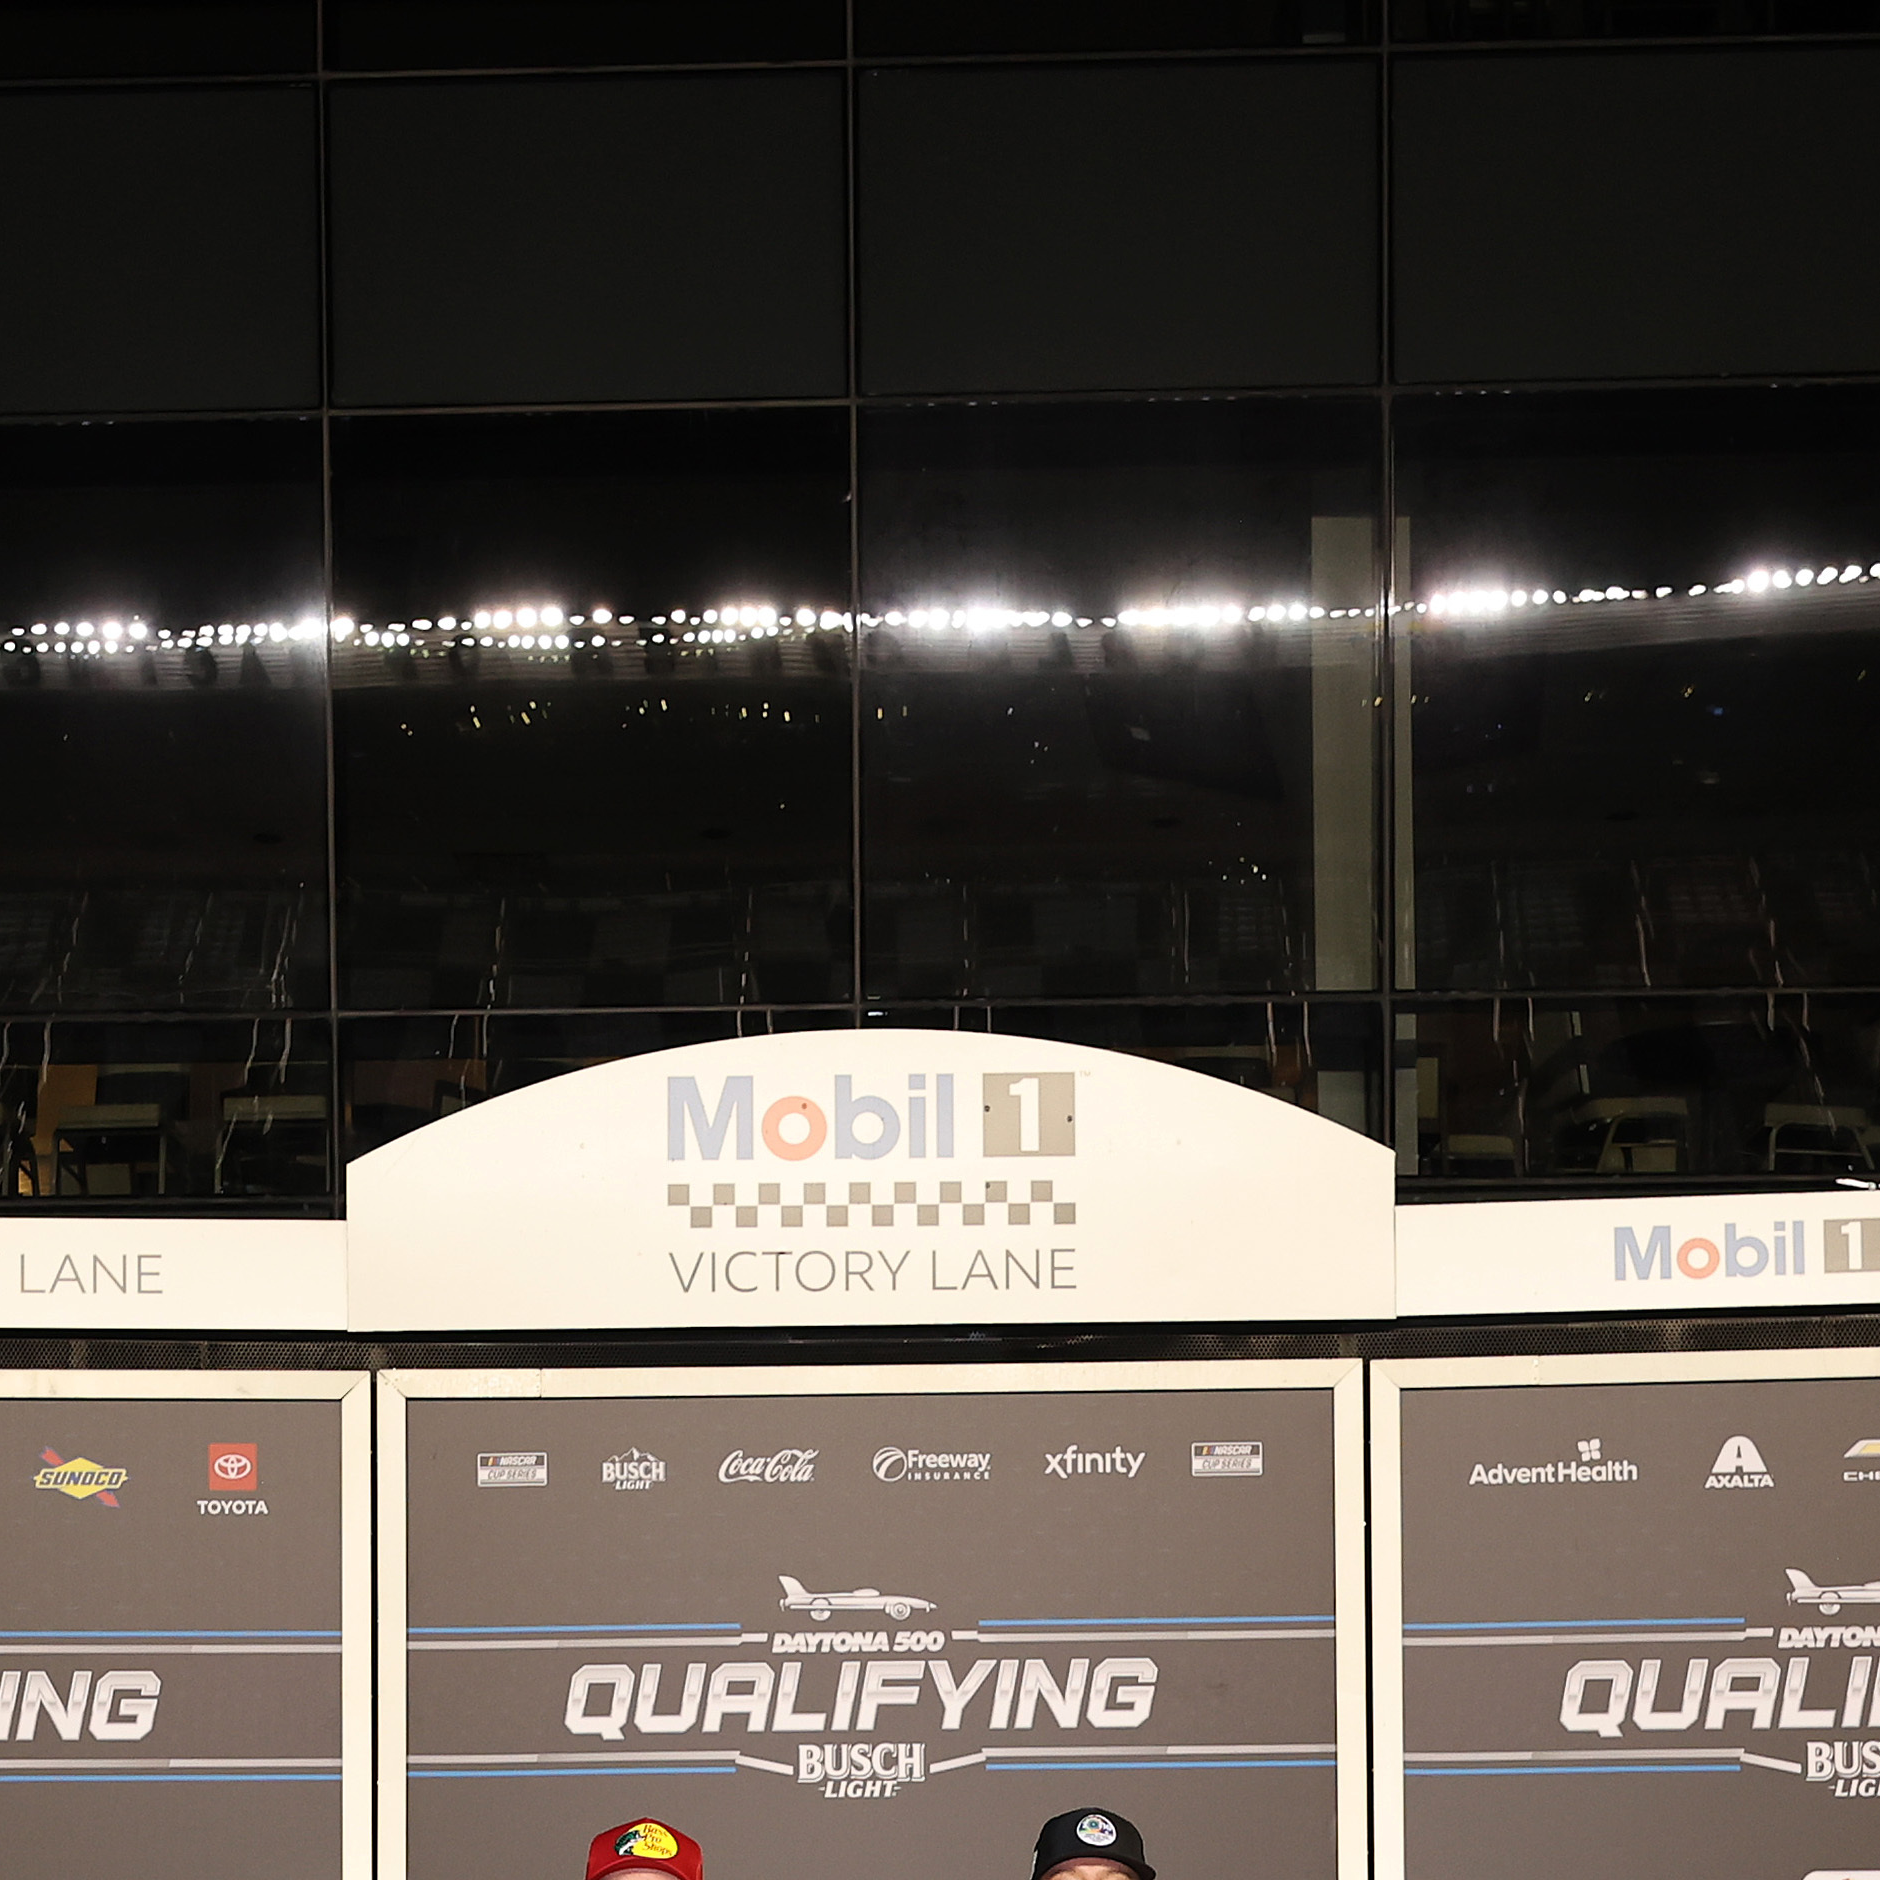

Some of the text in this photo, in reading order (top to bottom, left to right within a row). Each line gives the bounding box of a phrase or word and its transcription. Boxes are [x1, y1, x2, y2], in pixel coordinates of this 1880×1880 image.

[667, 1074, 954, 1160] Mobil
[1613, 1221, 1805, 1282] Mobil
[21, 1253, 163, 1296] LANE
[669, 1249, 1077, 1293] VICTORY LANE
[501, 1456, 536, 1465] NASCAR
[719, 1448, 819, 1484] Coca-Cola
[907, 1451, 991, 1471] Freeway
[1044, 1446, 1145, 1478] xfinity
[38, 1469, 125, 1487] SUNOCO
[602, 1462, 665, 1483] BUSCH
[908, 1472, 989, 1480] INSURANCE
[1469, 1460, 1637, 1485] AdventHealth
[1705, 1474, 1773, 1489] AXALTA
[616, 1480, 652, 1490] LIGHT
[198, 1501, 268, 1515] TOYOTA
[772, 1631, 944, 1653] DAYTONA 500
[564, 1657, 1158, 1740] QUALIFYING
[798, 1742, 925, 1783] BUSCH
[826, 1780, 896, 1798] LIGHT
